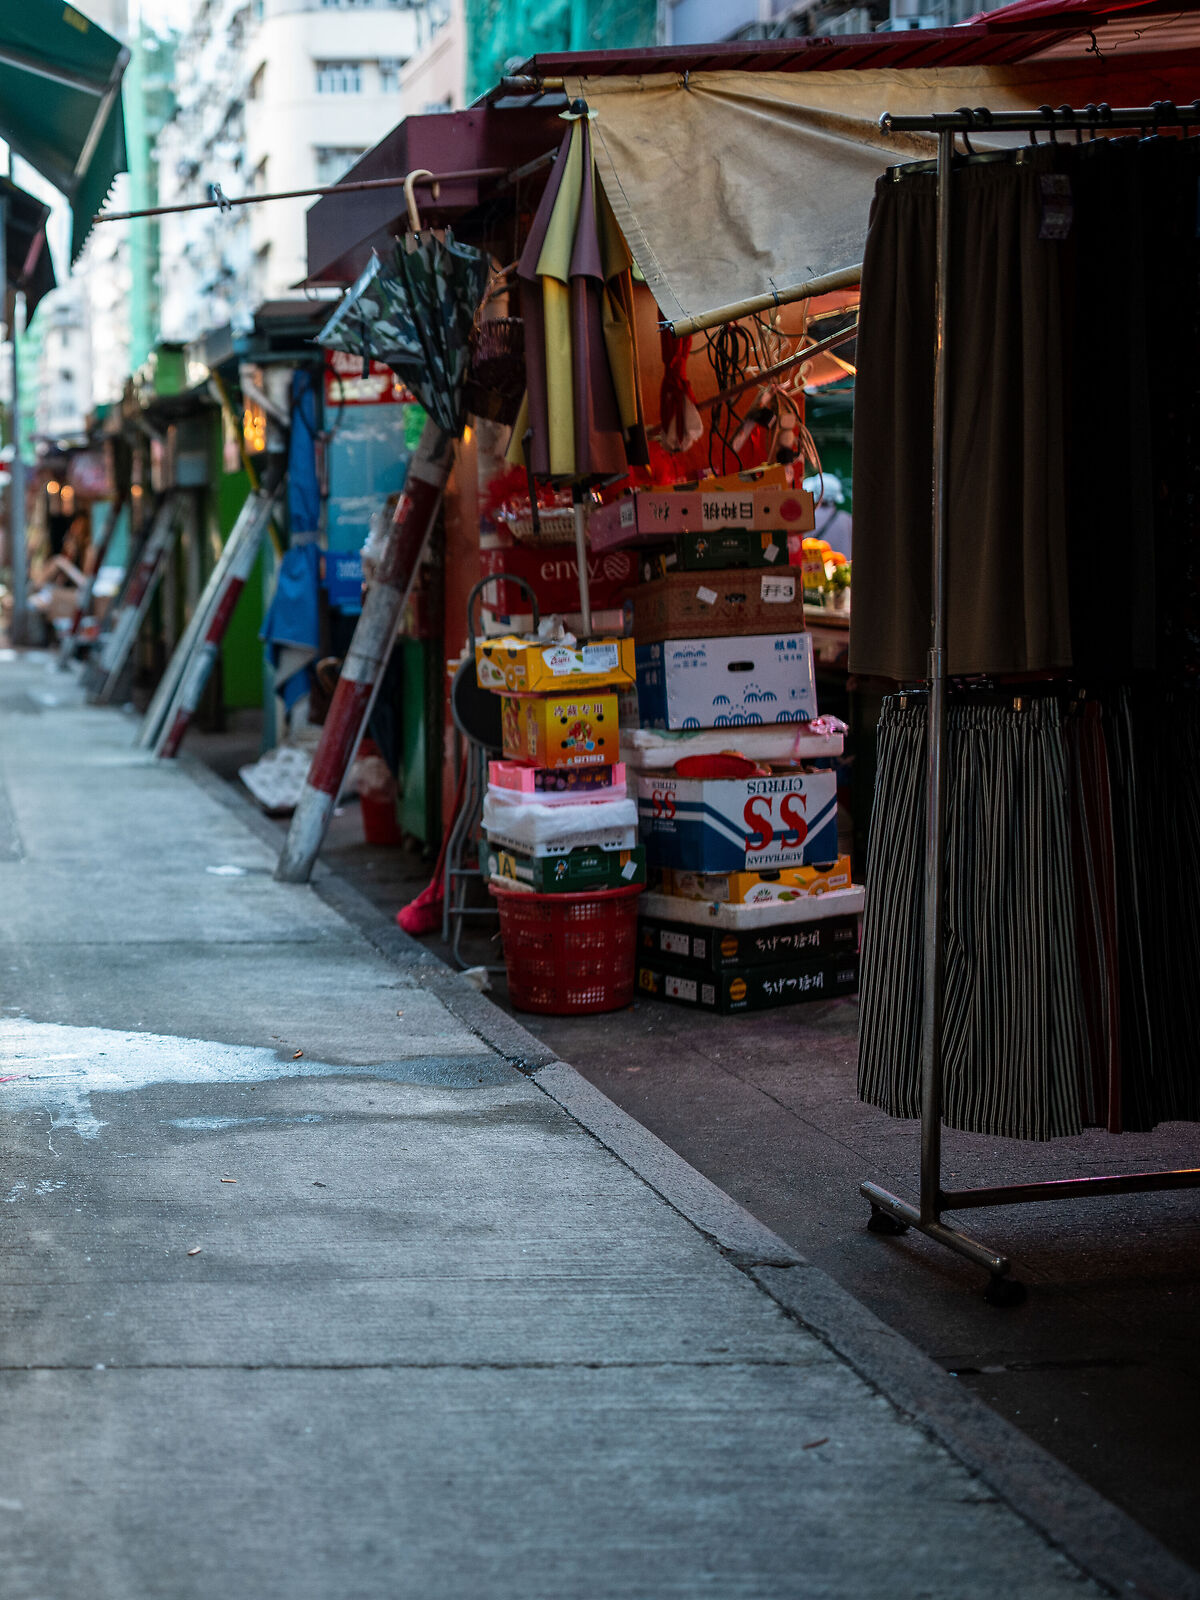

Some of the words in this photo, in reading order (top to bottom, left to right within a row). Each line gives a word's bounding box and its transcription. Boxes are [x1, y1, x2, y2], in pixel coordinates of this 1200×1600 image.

[541, 557, 605, 584] envy
[747, 778, 803, 794] CITRUS
[743, 793, 808, 852] SS
